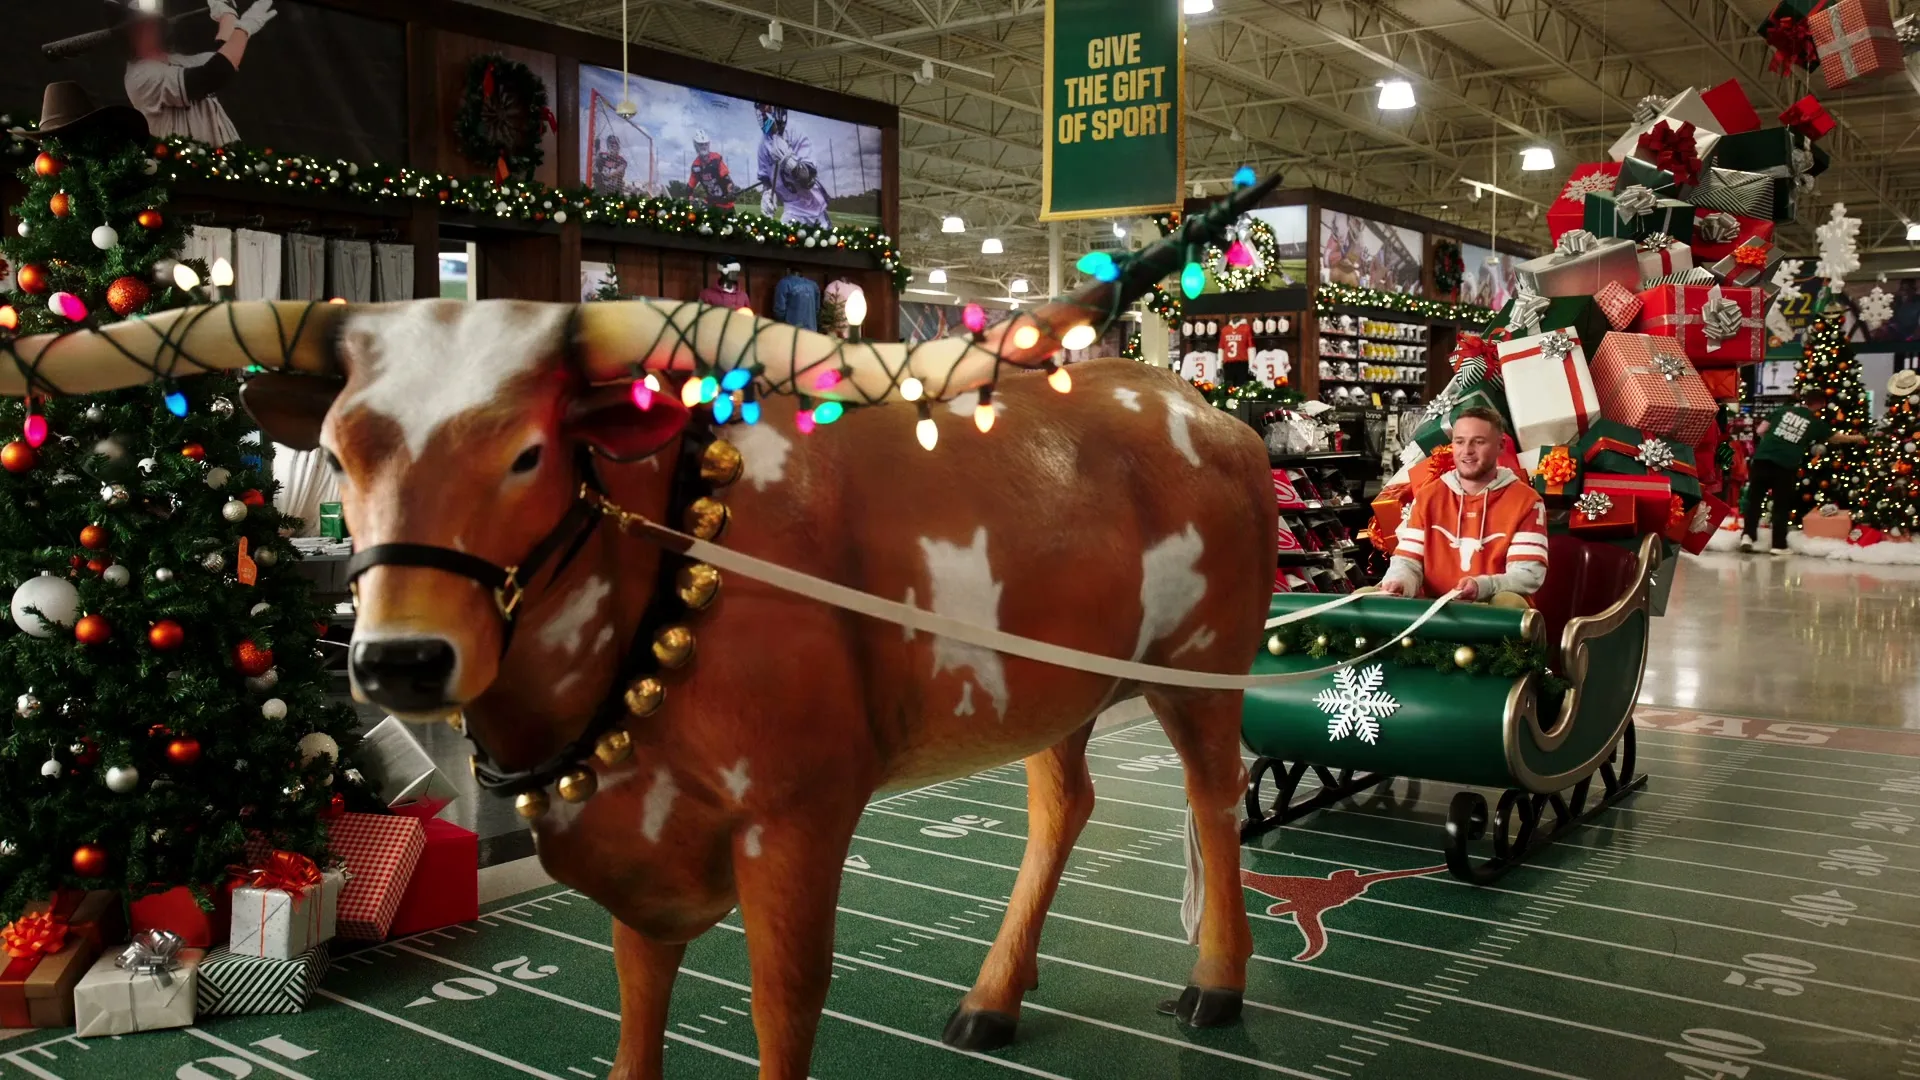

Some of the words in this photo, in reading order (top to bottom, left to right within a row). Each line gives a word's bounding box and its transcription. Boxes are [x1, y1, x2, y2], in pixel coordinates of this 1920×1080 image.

[1088, 33, 1141, 70] GIVE
[1064, 74, 1108, 108] THE
[1113, 66, 1166, 102] GIFT
[1058, 111, 1087, 144] OF
[1091, 102, 1171, 141] SPORT
[1227, 341, 1237, 358] 3
[1195, 363, 1204, 378] 3
[1266, 364, 1275, 380] 3
[1782, 411, 1810, 432] GIVE
[920, 814, 1004, 838] 50
[1851, 810, 1916, 834] 20
[1818, 848, 1889, 876] 30
[1781, 894, 1858, 928] 40
[431, 955, 560, 1001] 20
[1722, 953, 1818, 996] 50
[175, 1034, 319, 1080] 10
[1664, 1028, 1767, 1080] 40
